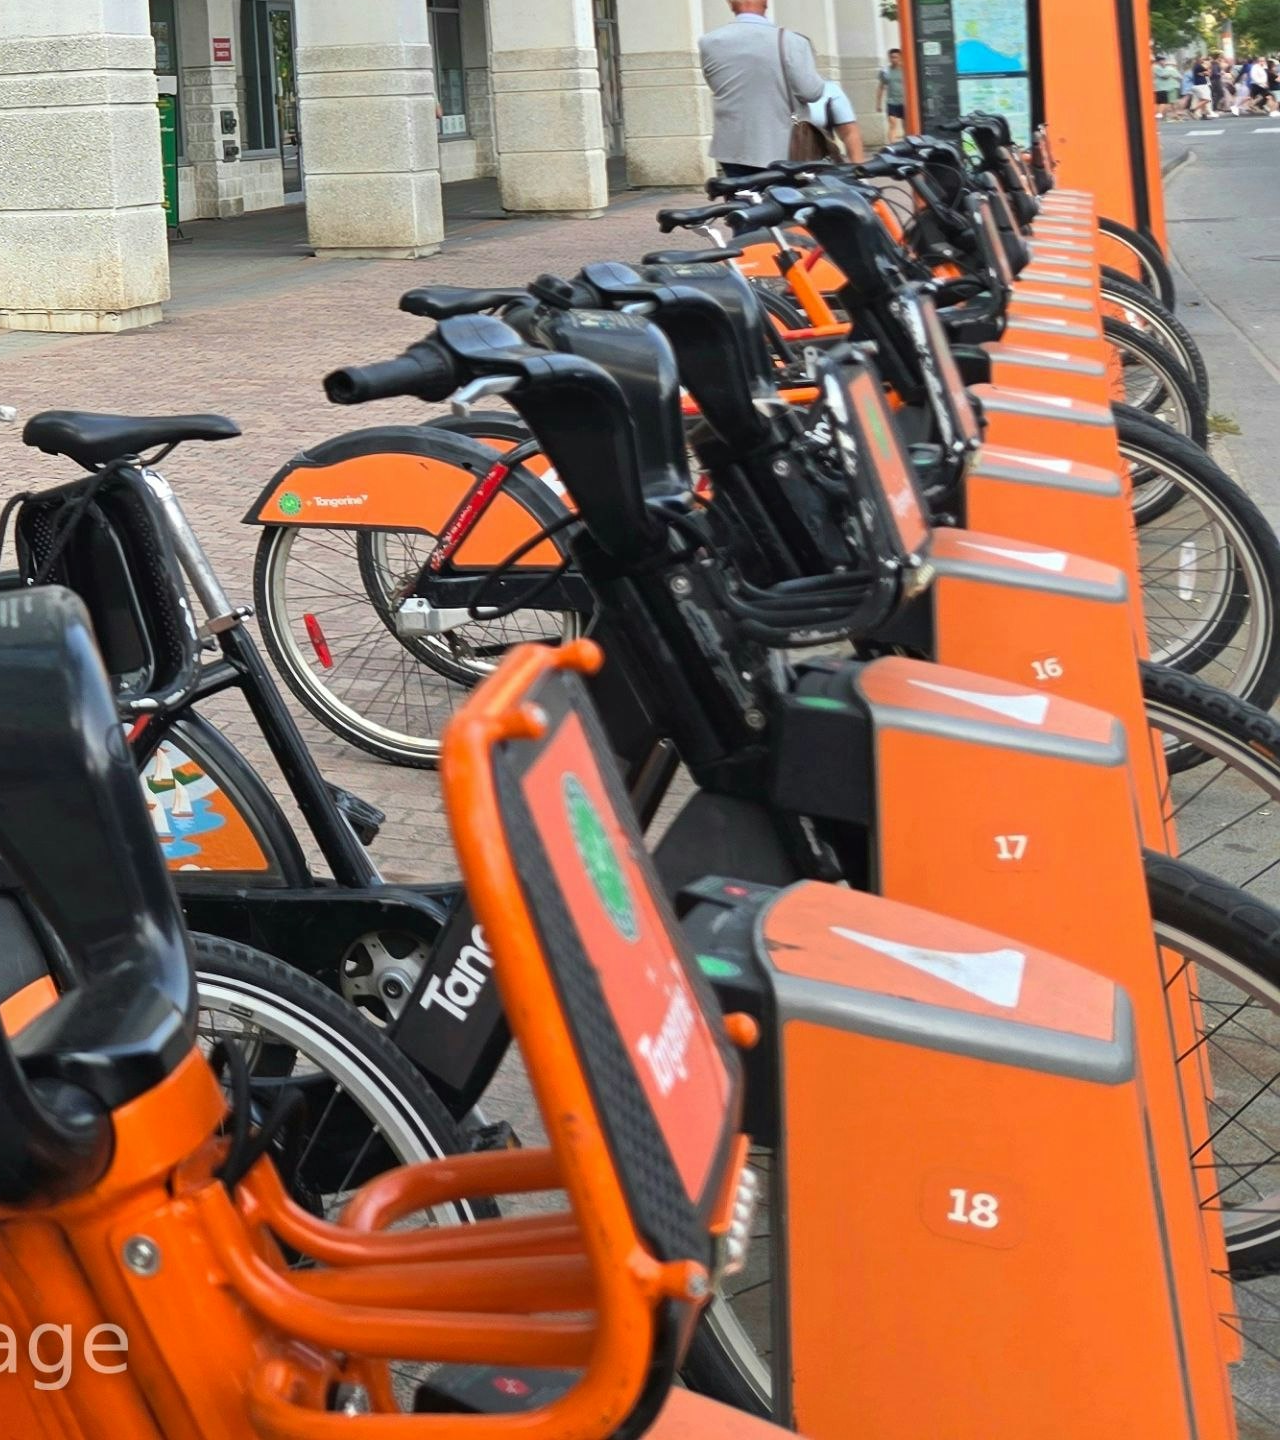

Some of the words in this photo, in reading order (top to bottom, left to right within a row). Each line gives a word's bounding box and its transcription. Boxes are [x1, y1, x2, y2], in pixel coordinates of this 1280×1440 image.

[1031, 657, 1063, 680] 16
[994, 834, 1028, 860] 17
[947, 1188, 999, 1229] 18
